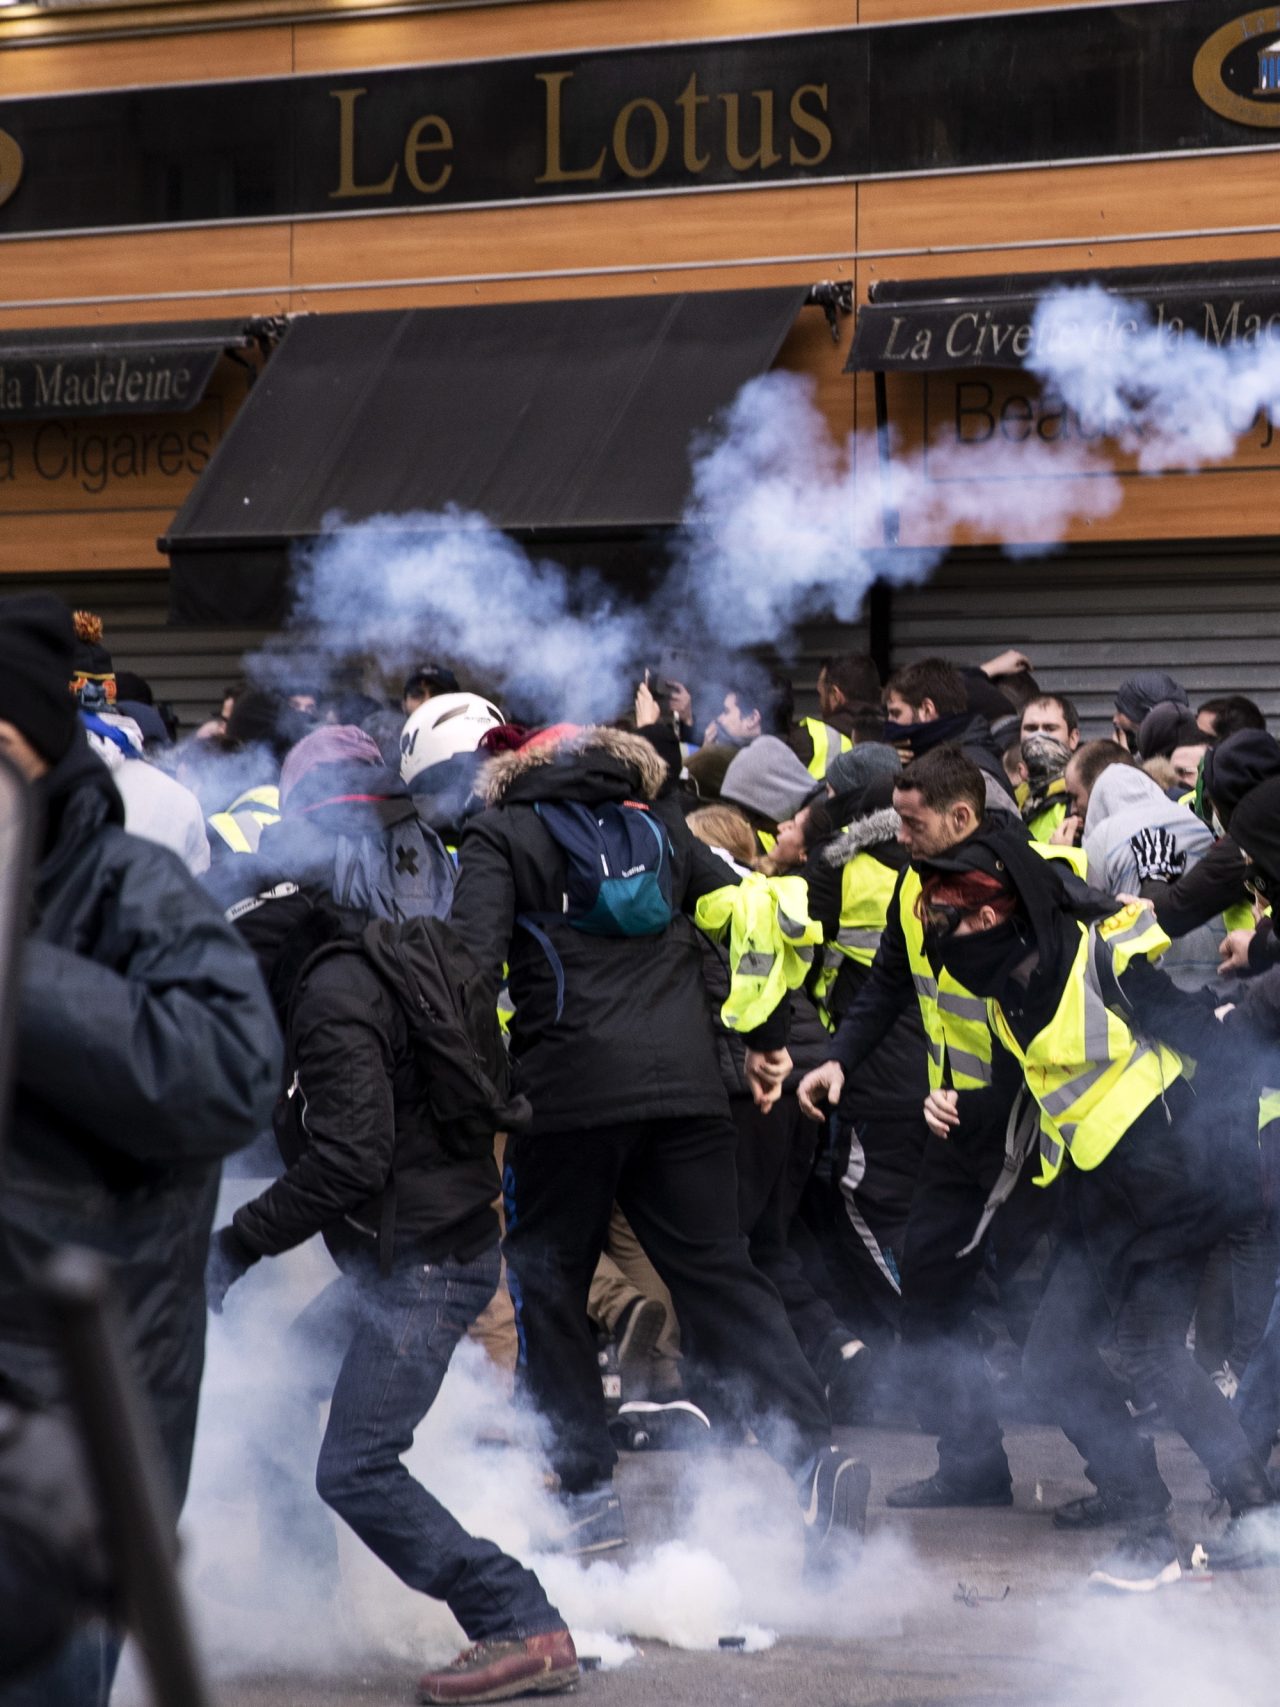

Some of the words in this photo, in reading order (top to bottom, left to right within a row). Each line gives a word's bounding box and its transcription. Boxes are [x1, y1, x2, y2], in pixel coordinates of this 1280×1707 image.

[328, 87, 454, 198] Le
[534, 70, 833, 184] Lotus
[879, 316, 933, 361] La
[945, 310, 1081, 358] Civete
[35, 357, 192, 408] Madeleine
[955, 380, 1146, 444] Beau
[33, 419, 212, 494] Cigares
